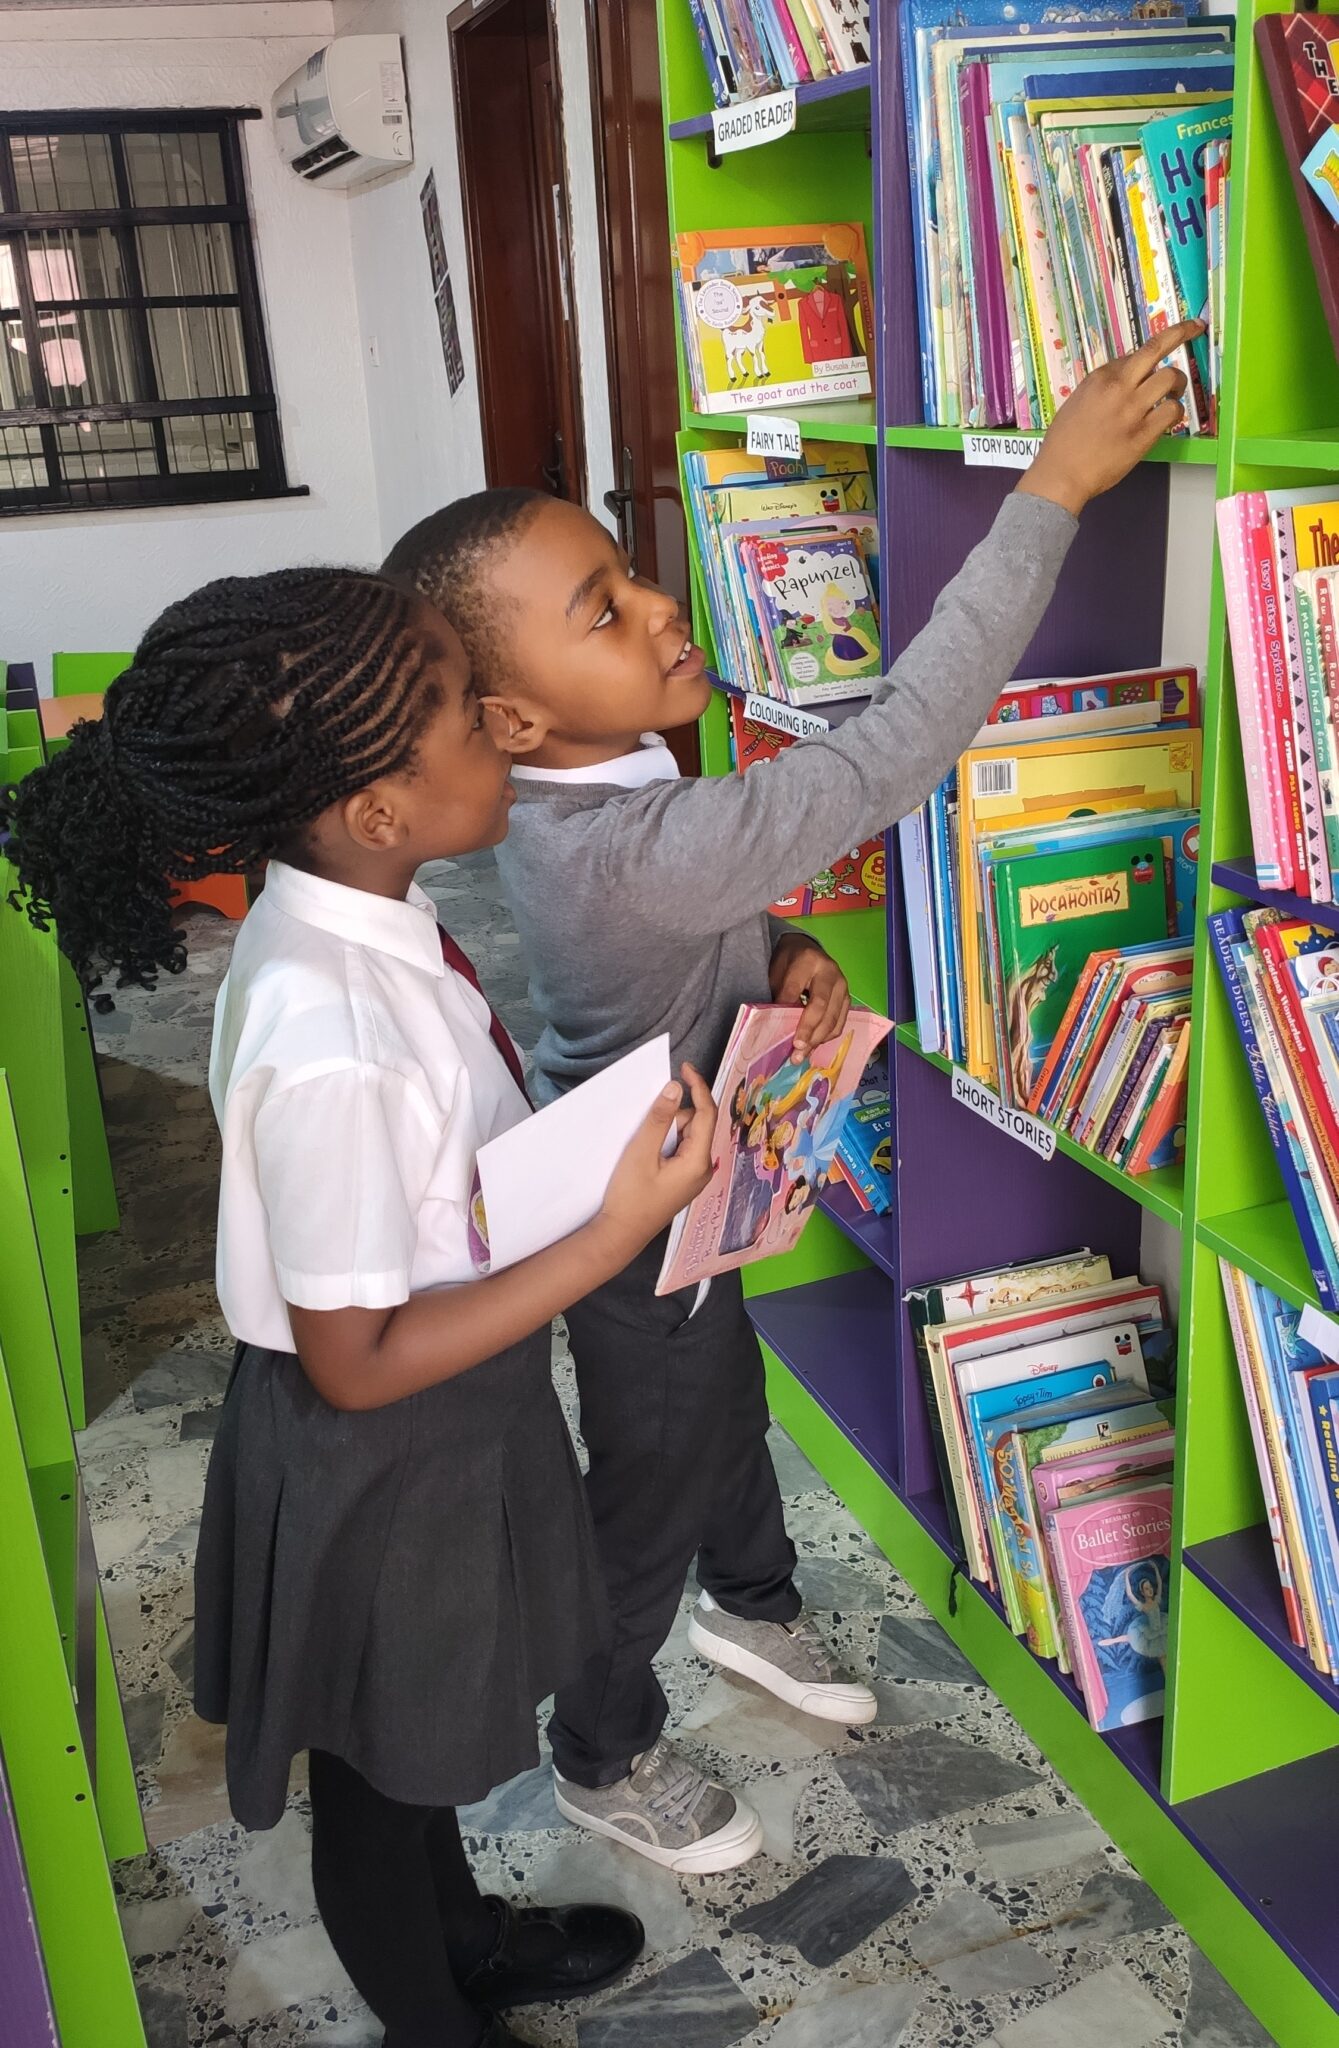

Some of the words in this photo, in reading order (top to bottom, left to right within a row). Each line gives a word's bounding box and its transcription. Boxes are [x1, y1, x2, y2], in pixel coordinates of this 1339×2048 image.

[1303, 41, 1339, 96] THE
[718, 114, 752, 142] GRADED
[755, 100, 793, 131] READER
[813, 365, 824, 374] By
[825, 362, 849, 371] Busola
[850, 360, 866, 369] Aina
[731, 392, 753, 404] The
[757, 388, 782, 404] goat
[786, 384, 807, 396] and
[811, 381, 830, 393] the
[834, 378, 858, 390] coat
[751, 431, 774, 450] FAIRY
[777, 433, 799, 453] TALE
[972, 438, 1002, 453] STORY
[770, 459, 804, 477] Pooh
[1309, 518, 1339, 567] The
[773, 560, 857, 600] Rapunzel
[1260, 559, 1271, 590] Itsy
[1265, 596, 1277, 635] Bitsy
[750, 700, 800, 732] COLOURING
[1311, 688, 1321, 713] had
[1317, 731, 1326, 762] farm
[1176, 856, 1196, 875] story
[1028, 879, 1121, 921] POCAHONTAS
[1125, 1007, 1135, 1019] TOM
[1263, 947, 1284, 996] Christmas
[1280, 994, 1306, 1053] Wonderland
[1255, 983, 1272, 1030] Religious
[1268, 1029, 1281, 1060] Books
[1231, 982, 1254, 1035] DIGEST
[1246, 1042, 1267, 1086] Bible
[1261, 1092, 1281, 1148] Children
[955, 1078, 995, 1117] SHORT
[997, 1107, 1052, 1153] STORIES
[1027, 1362, 1059, 1376] Disney
[1013, 1391, 1036, 1407] Topsy
[1038, 1387, 1053, 1399] Tim
[995, 1446, 1016, 1480] 50
[1322, 1420, 1339, 1482] Reading
[998, 1479, 1031, 1556] Magical
[1077, 1529, 1119, 1550] Ballet
[1121, 1516, 1171, 1539] Stories
[1101, 1513, 1130, 1525] TREASURY
